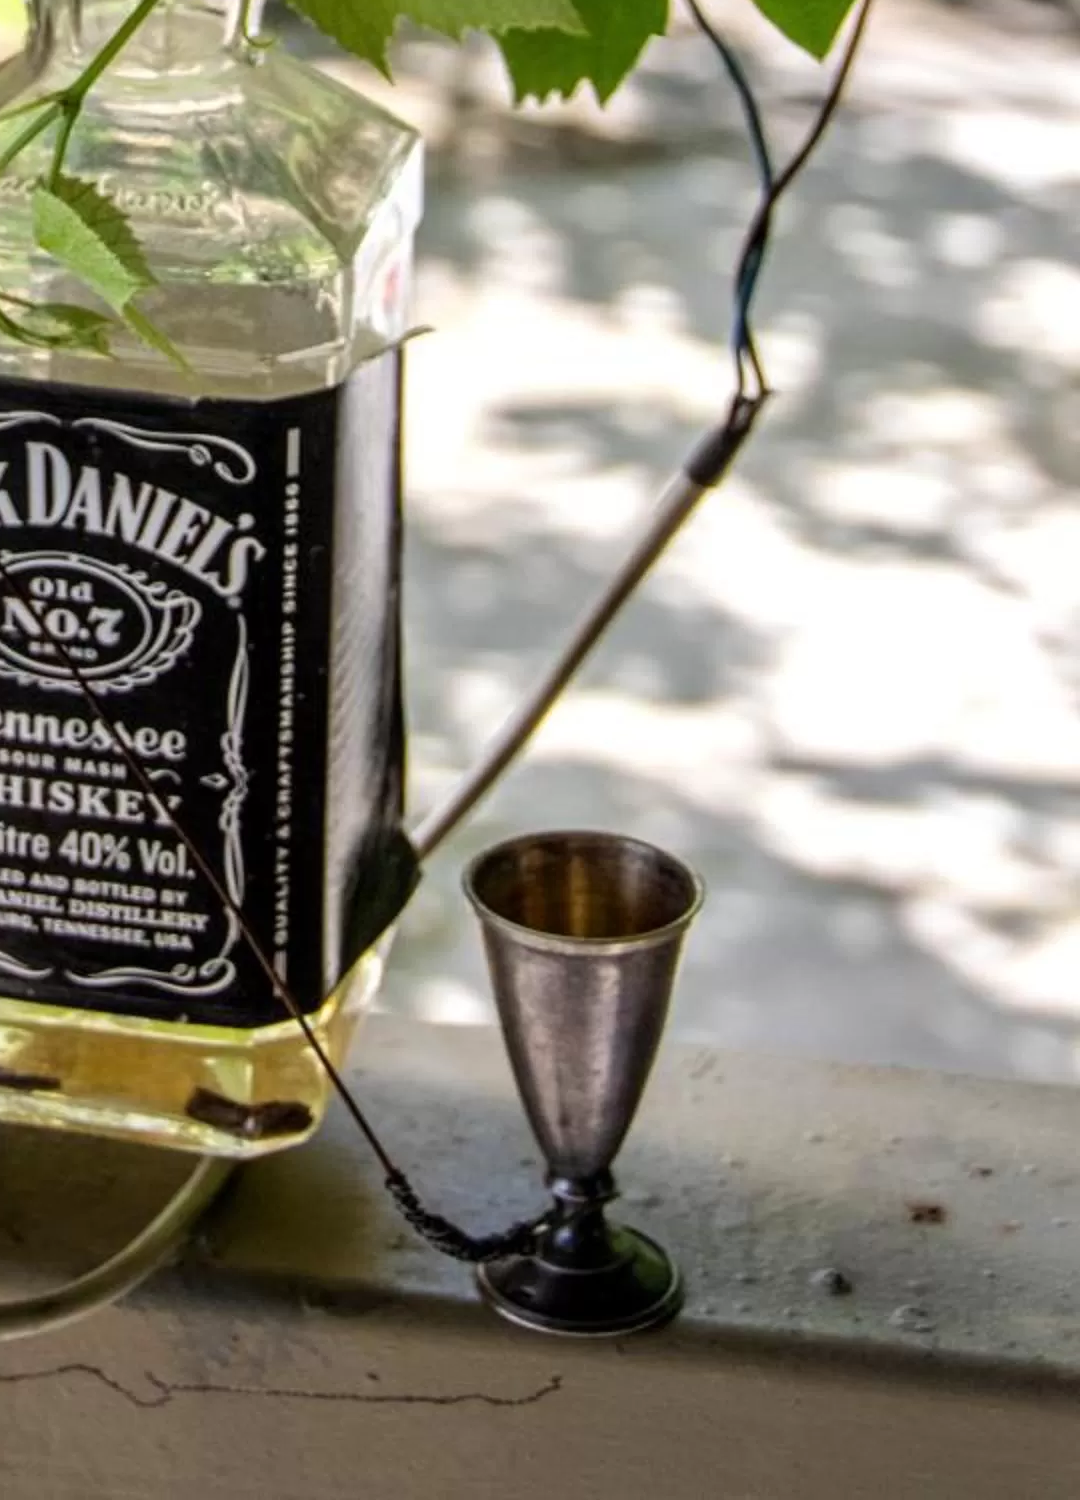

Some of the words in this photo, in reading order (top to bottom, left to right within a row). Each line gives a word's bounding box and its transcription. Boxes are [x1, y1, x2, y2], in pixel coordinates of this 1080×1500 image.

[24, 440, 267, 600] DANIEL'S
[58, 828, 132, 873] 40%
[138, 841, 197, 880] Vol.
